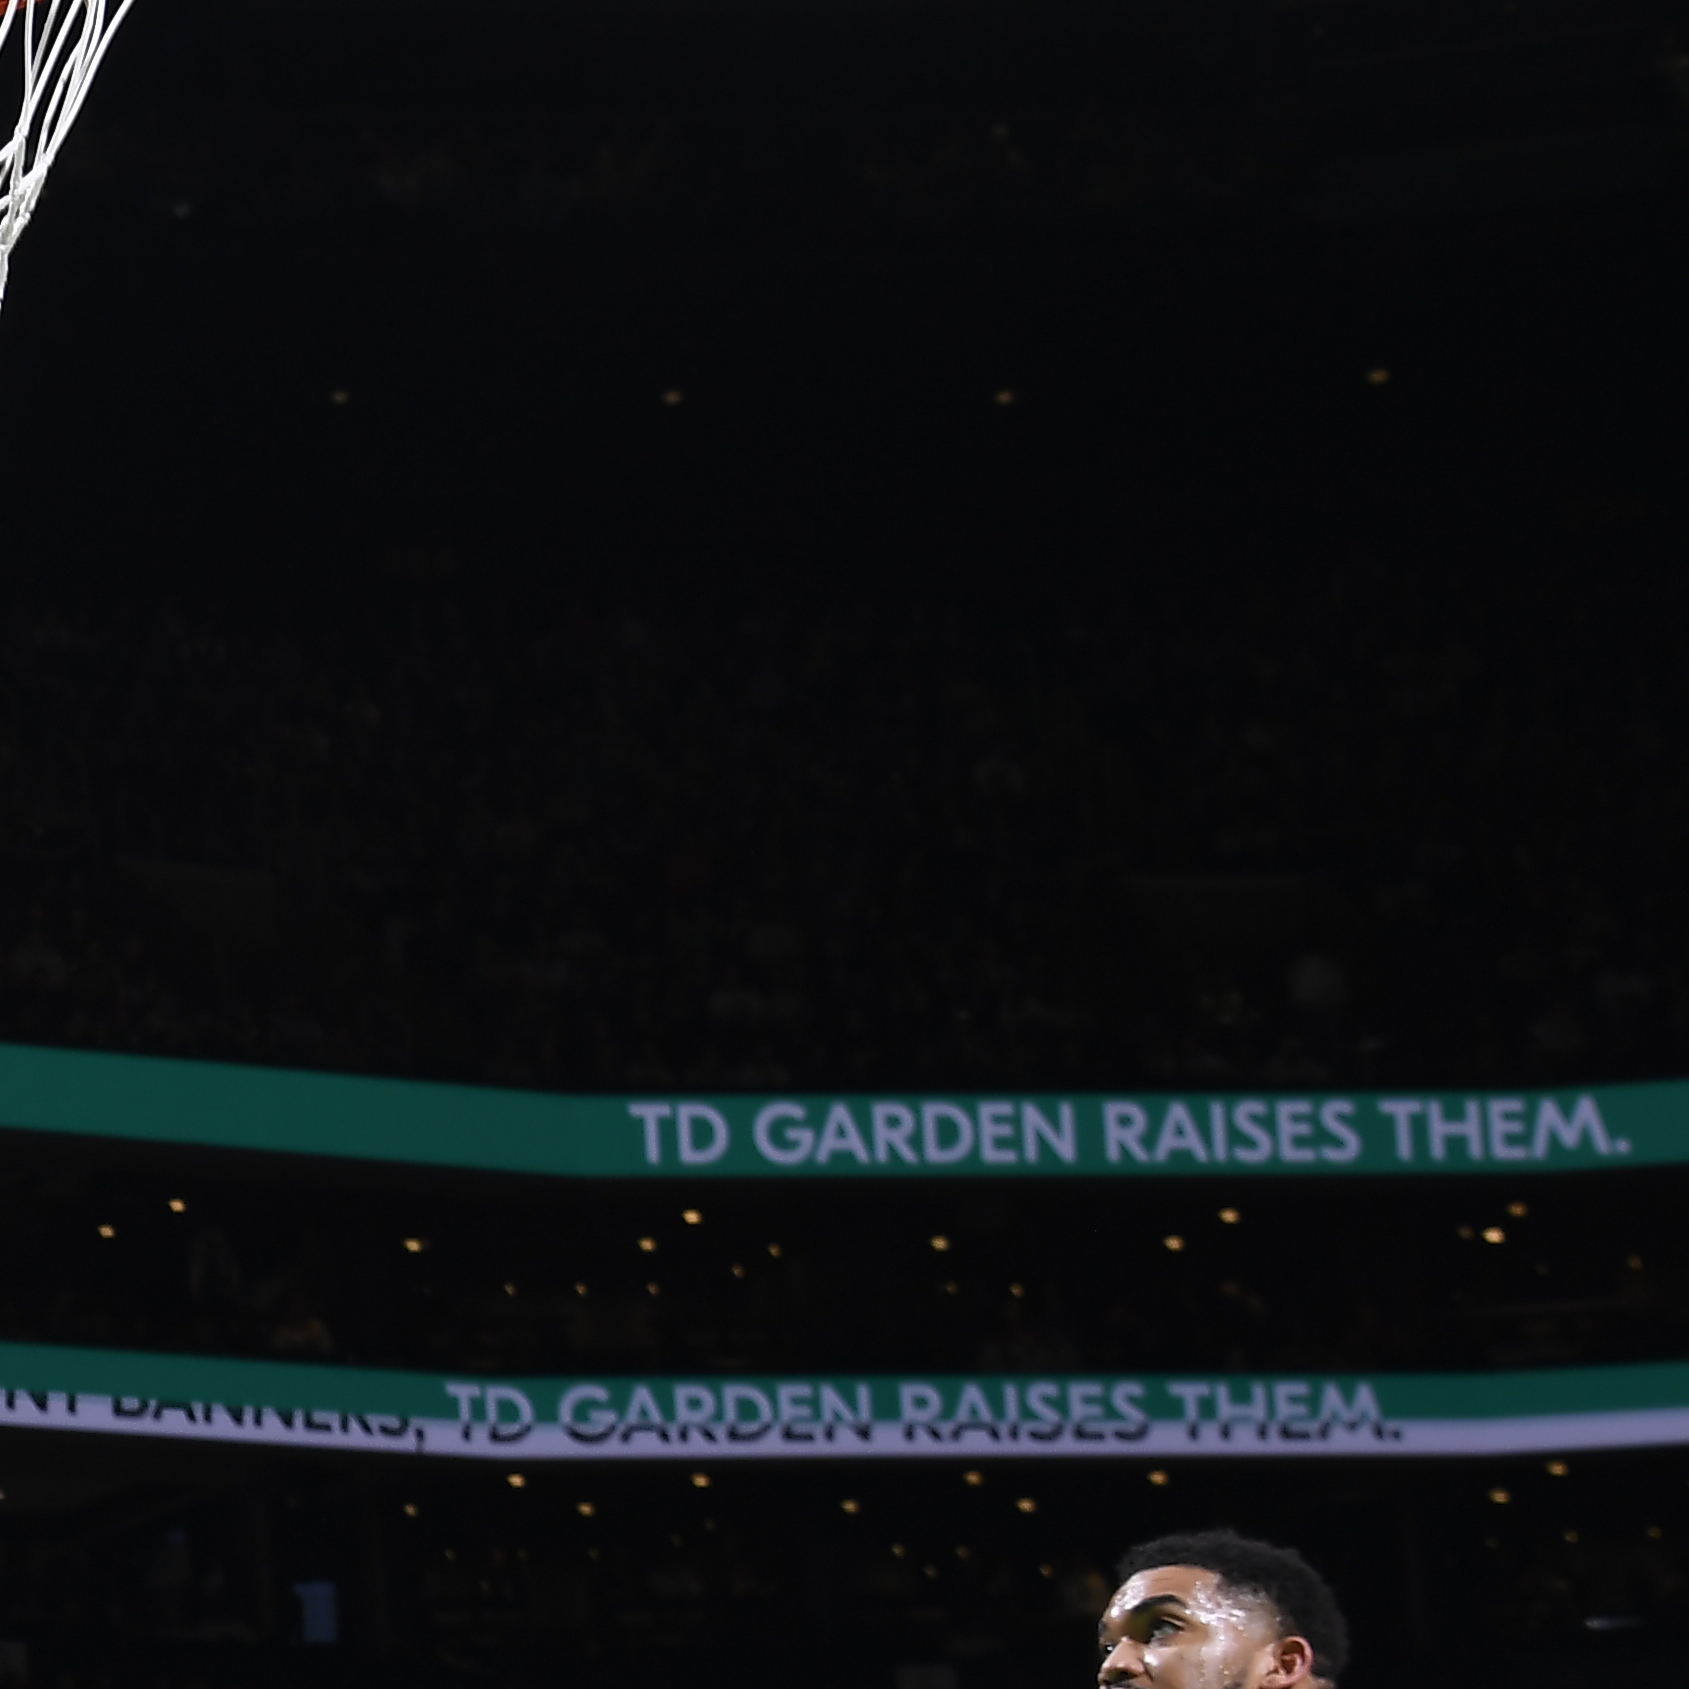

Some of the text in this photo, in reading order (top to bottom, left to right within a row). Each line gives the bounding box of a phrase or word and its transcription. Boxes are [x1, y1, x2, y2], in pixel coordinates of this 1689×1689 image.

[629, 1096, 1631, 1165] TD GARDEN RAISES THEM.
[444, 1381, 532, 1443] TD
[557, 1383, 874, 1443] GARDEN
[897, 1381, 1150, 1443] RAISES
[1165, 1381, 1403, 1443] THEM.
